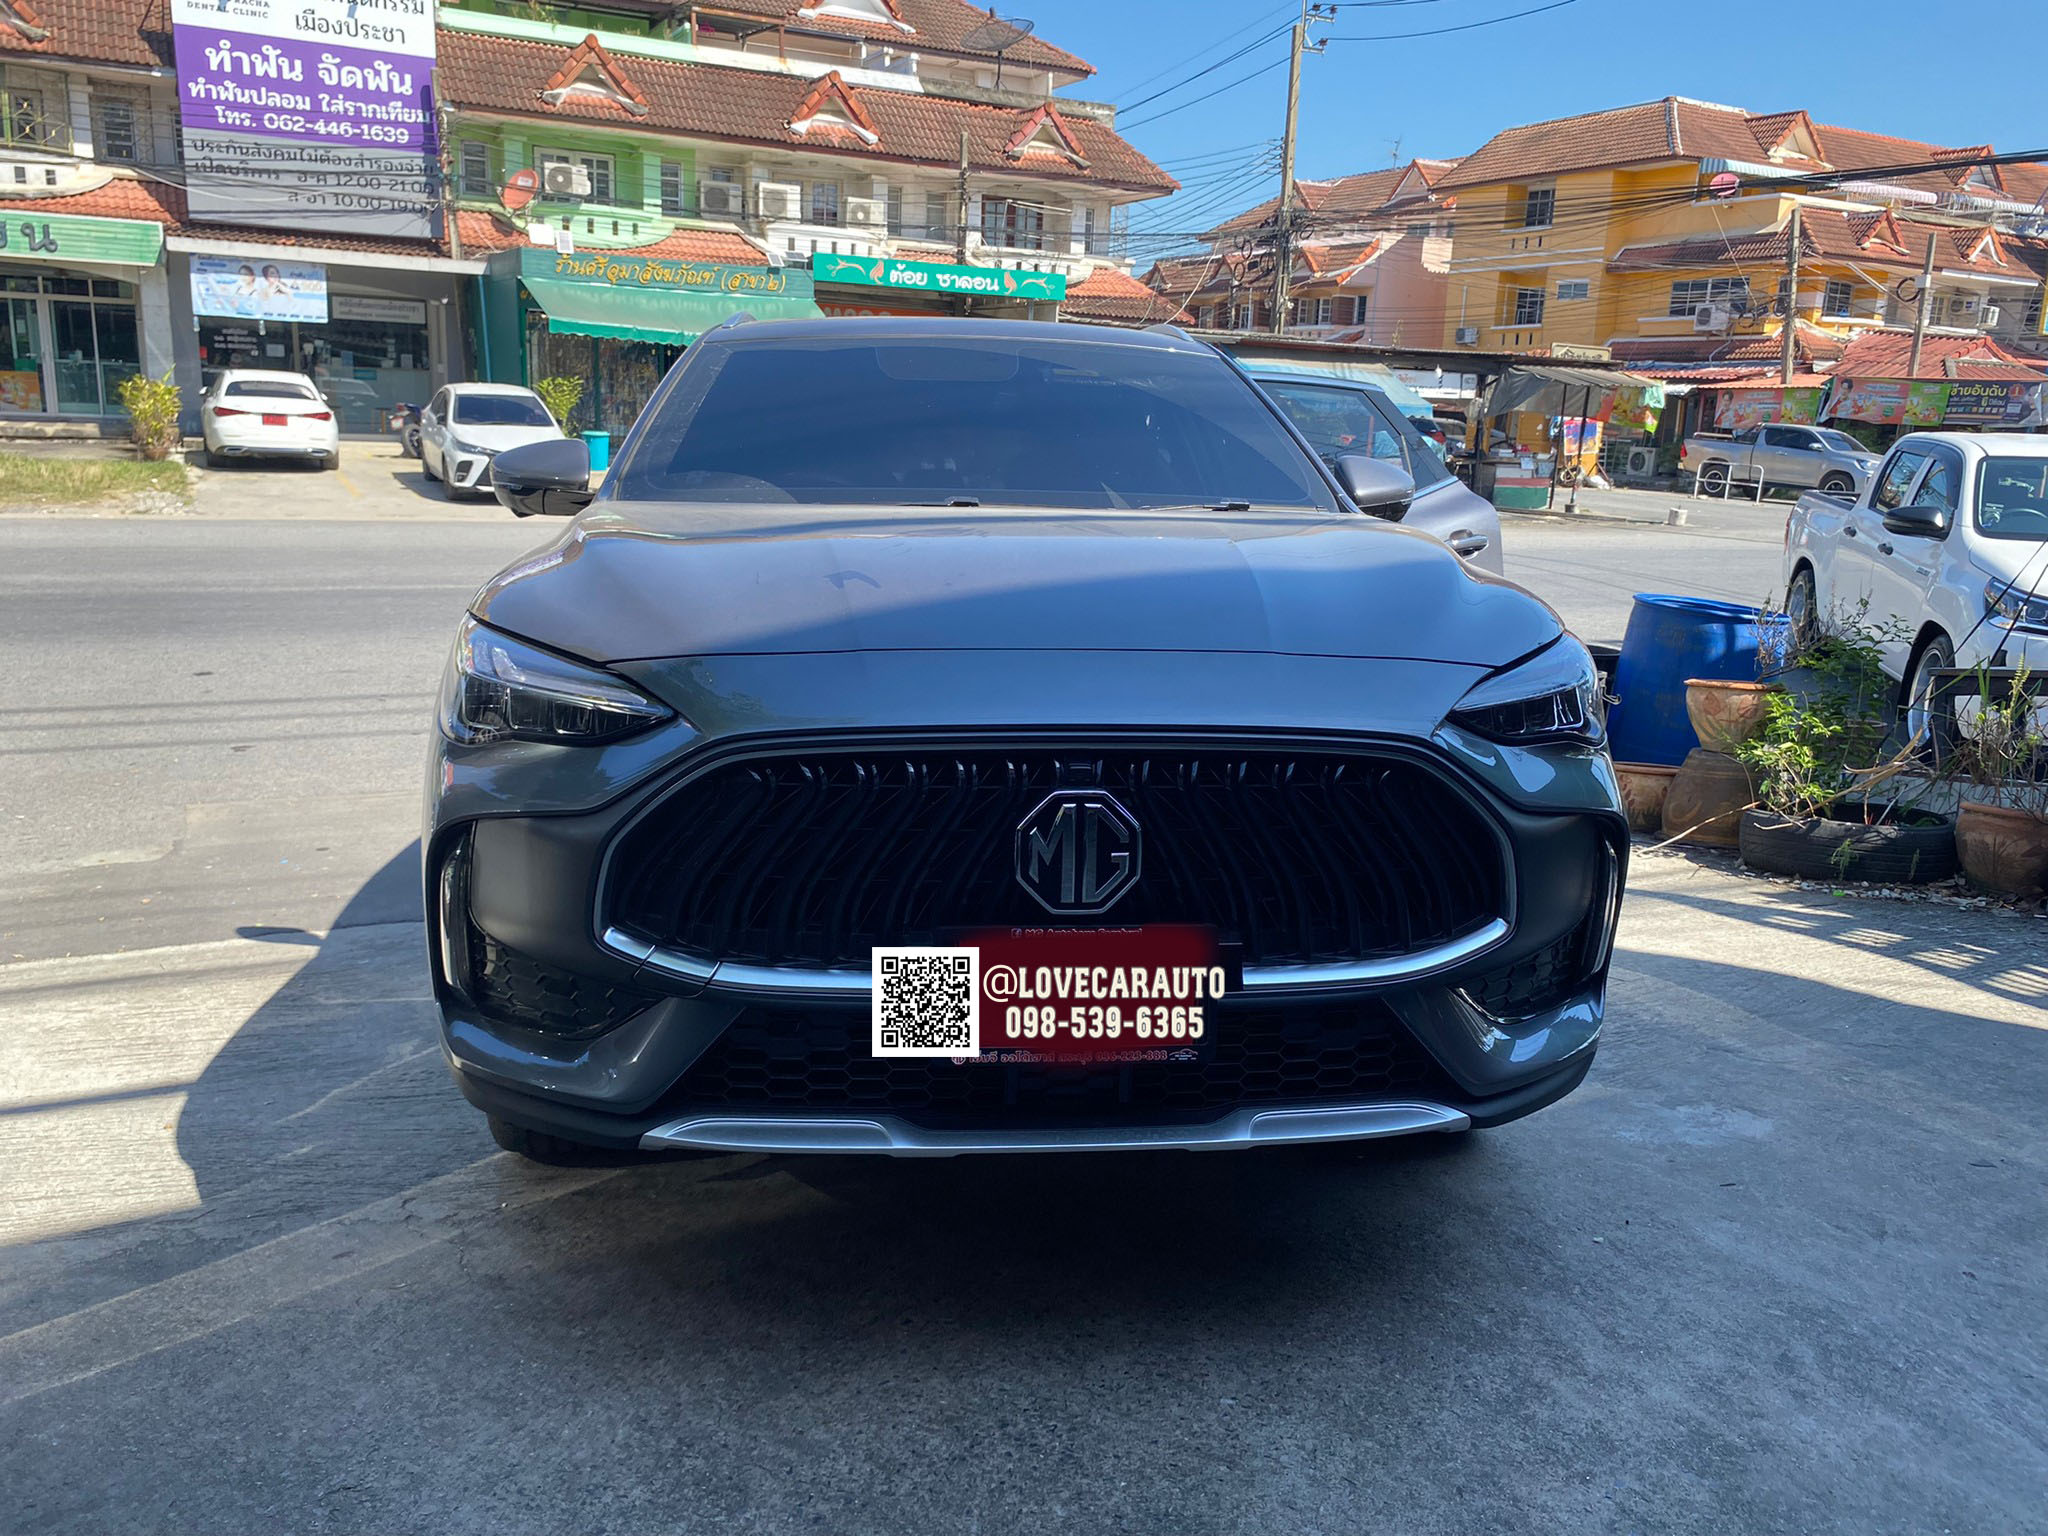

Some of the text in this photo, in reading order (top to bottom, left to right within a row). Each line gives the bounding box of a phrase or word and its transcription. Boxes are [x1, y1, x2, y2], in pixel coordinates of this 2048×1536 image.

[232, 7, 269, 19] CLINIC
[295, 8, 406, 44] เมืองประชา
[204, 39, 413, 96] ทำฟัน จัดฟัน
[188, 77, 431, 123] ทำฟันปลอม ใส่รากเทียม
[214, 106, 410, 144] โทร. 062-446-1639
[889, 263, 1000, 292] ต้อย ซาลอน
[1029, 803, 1130, 903] MG
